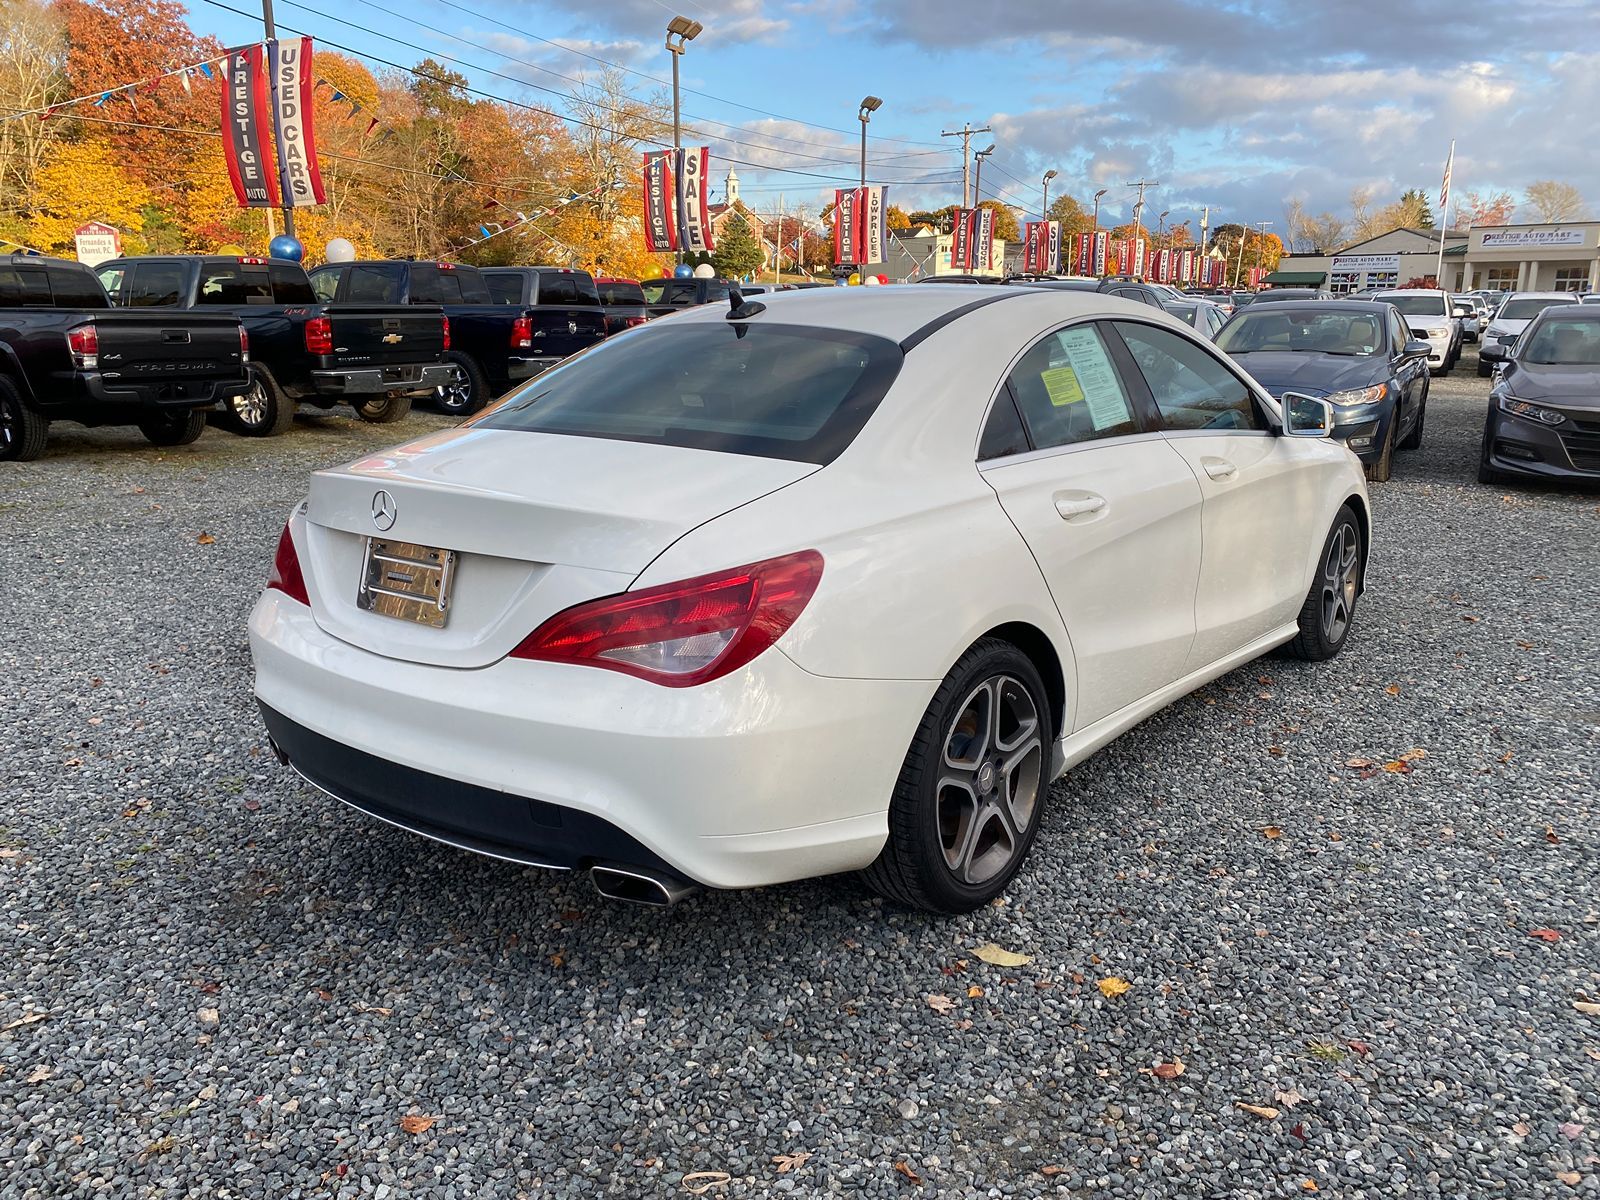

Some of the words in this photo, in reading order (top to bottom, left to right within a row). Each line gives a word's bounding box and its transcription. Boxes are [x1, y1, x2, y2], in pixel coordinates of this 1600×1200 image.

[281, 49, 296, 119] USED
[234, 55, 258, 180] PRESTIGE
[283, 125, 308, 195] CARS
[246, 187, 267, 200] AUTO
[651, 157, 664, 236] PRESTIGE
[685, 154, 701, 245] SALE
[842, 193, 851, 252] PRESTIGE
[870, 192, 879, 213] LOW
[870, 215, 878, 258] PRICES
[958, 212, 967, 259] PRESTIGE
[133, 362, 217, 371] TACOMA
